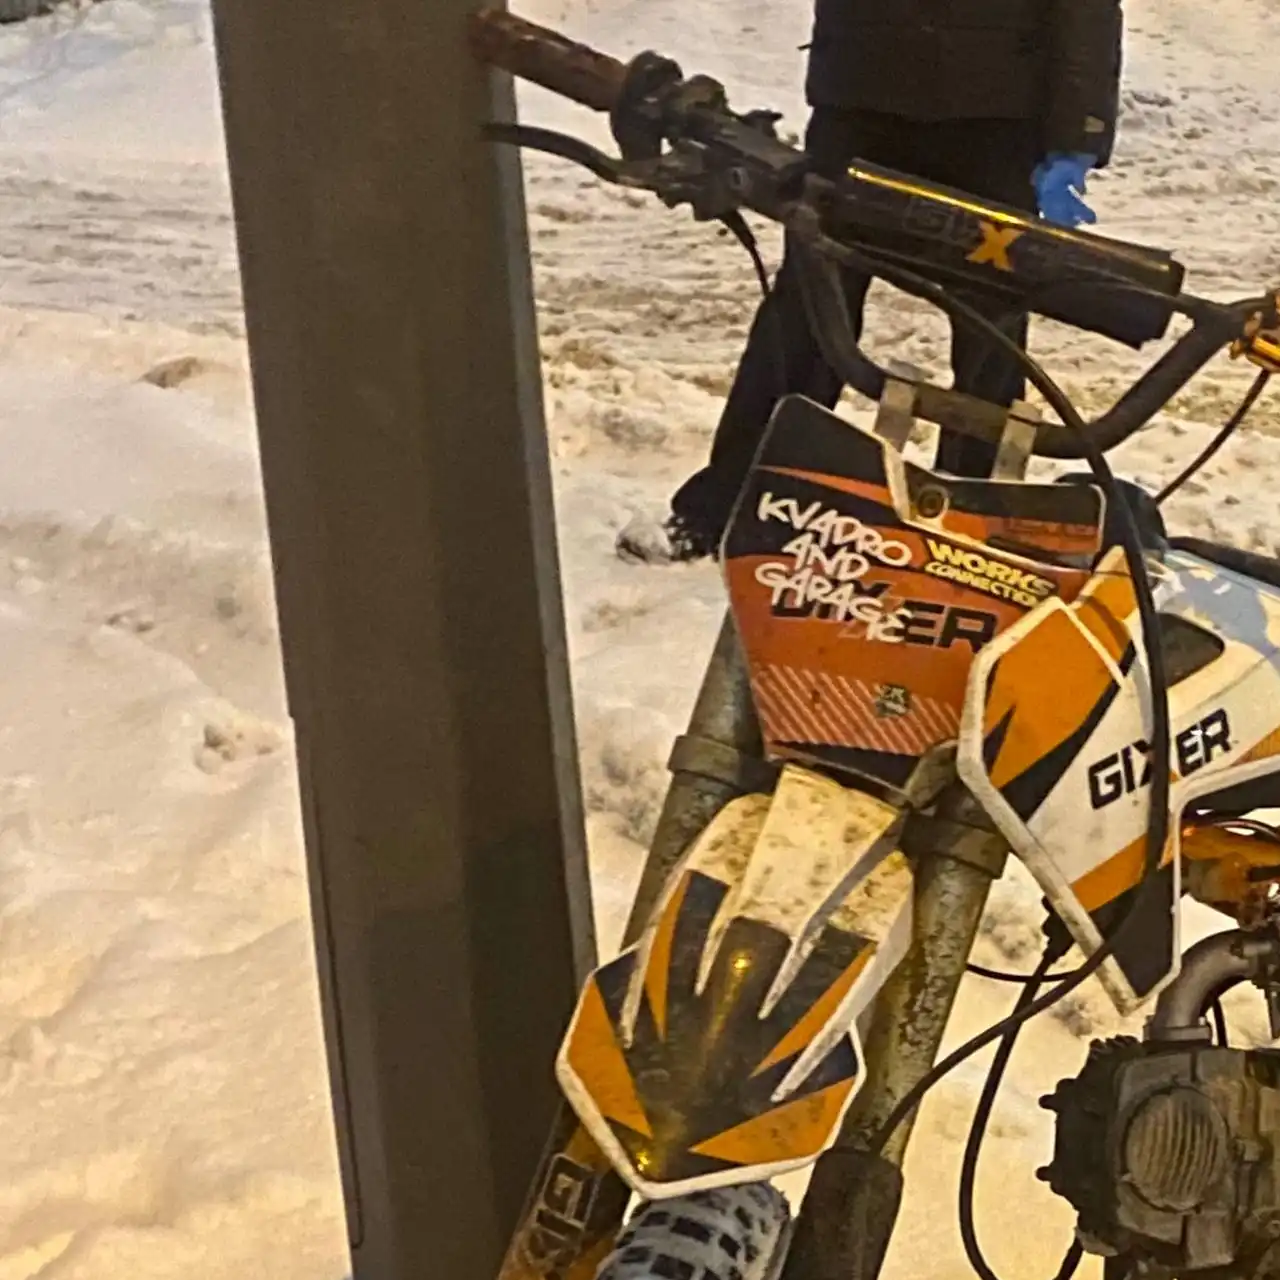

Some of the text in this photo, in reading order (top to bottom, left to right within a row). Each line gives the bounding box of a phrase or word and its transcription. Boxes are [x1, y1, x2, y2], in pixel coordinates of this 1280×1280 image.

[757, 491, 913, 567] KVADRO
[781, 532, 871, 581] AND
[924, 561, 1039, 608] CONNECTIO
[926, 538, 1057, 597] WORKS
[754, 562, 914, 643] GARAGE
